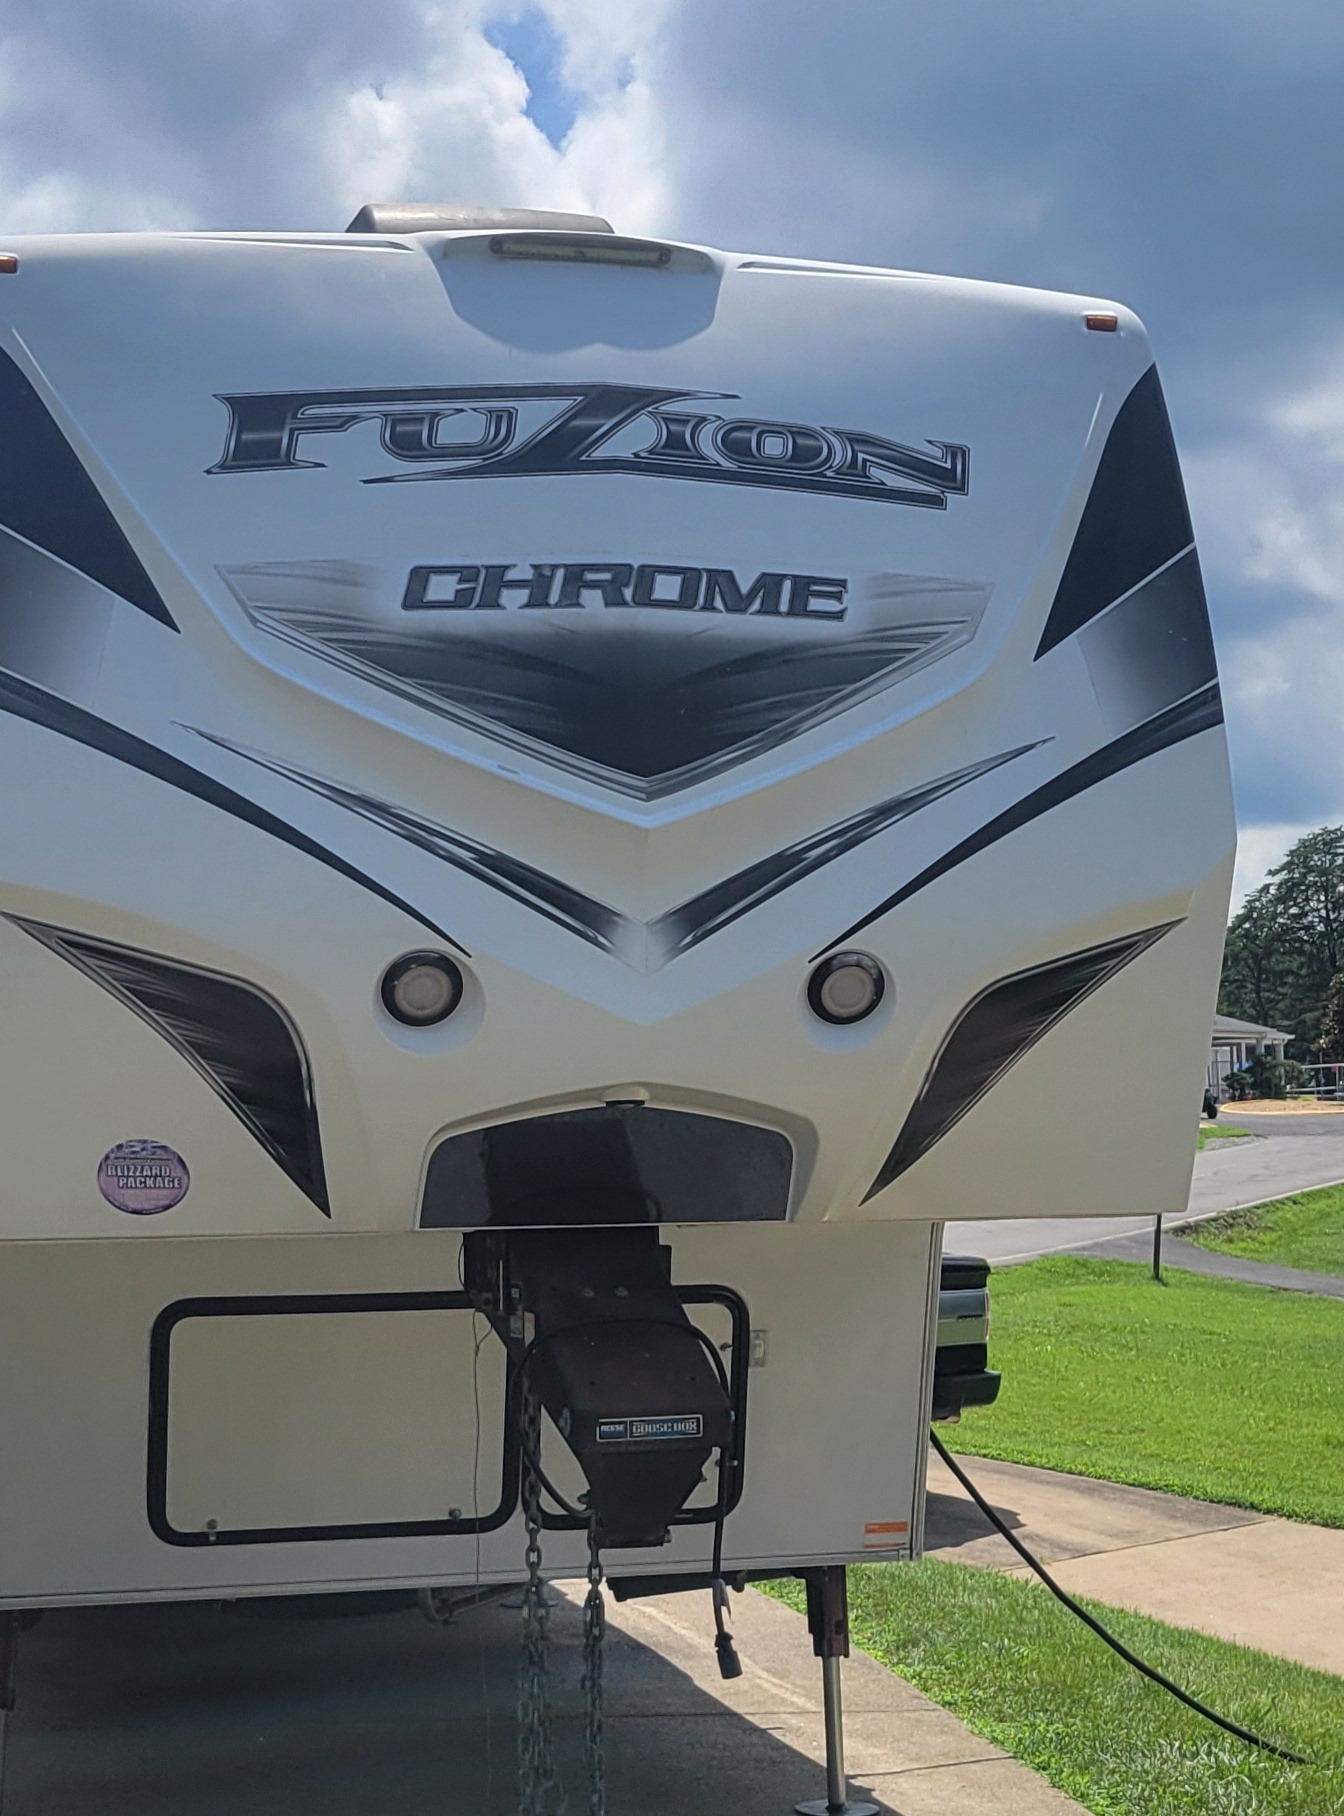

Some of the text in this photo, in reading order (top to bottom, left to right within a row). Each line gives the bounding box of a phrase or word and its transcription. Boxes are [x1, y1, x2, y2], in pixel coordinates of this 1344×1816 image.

[204, 381, 971, 510] FUZION
[401, 563, 849, 622] CHROME
[107, 1164, 171, 1176] BLIZZARD
[118, 1176, 182, 1189] PACKAGE
